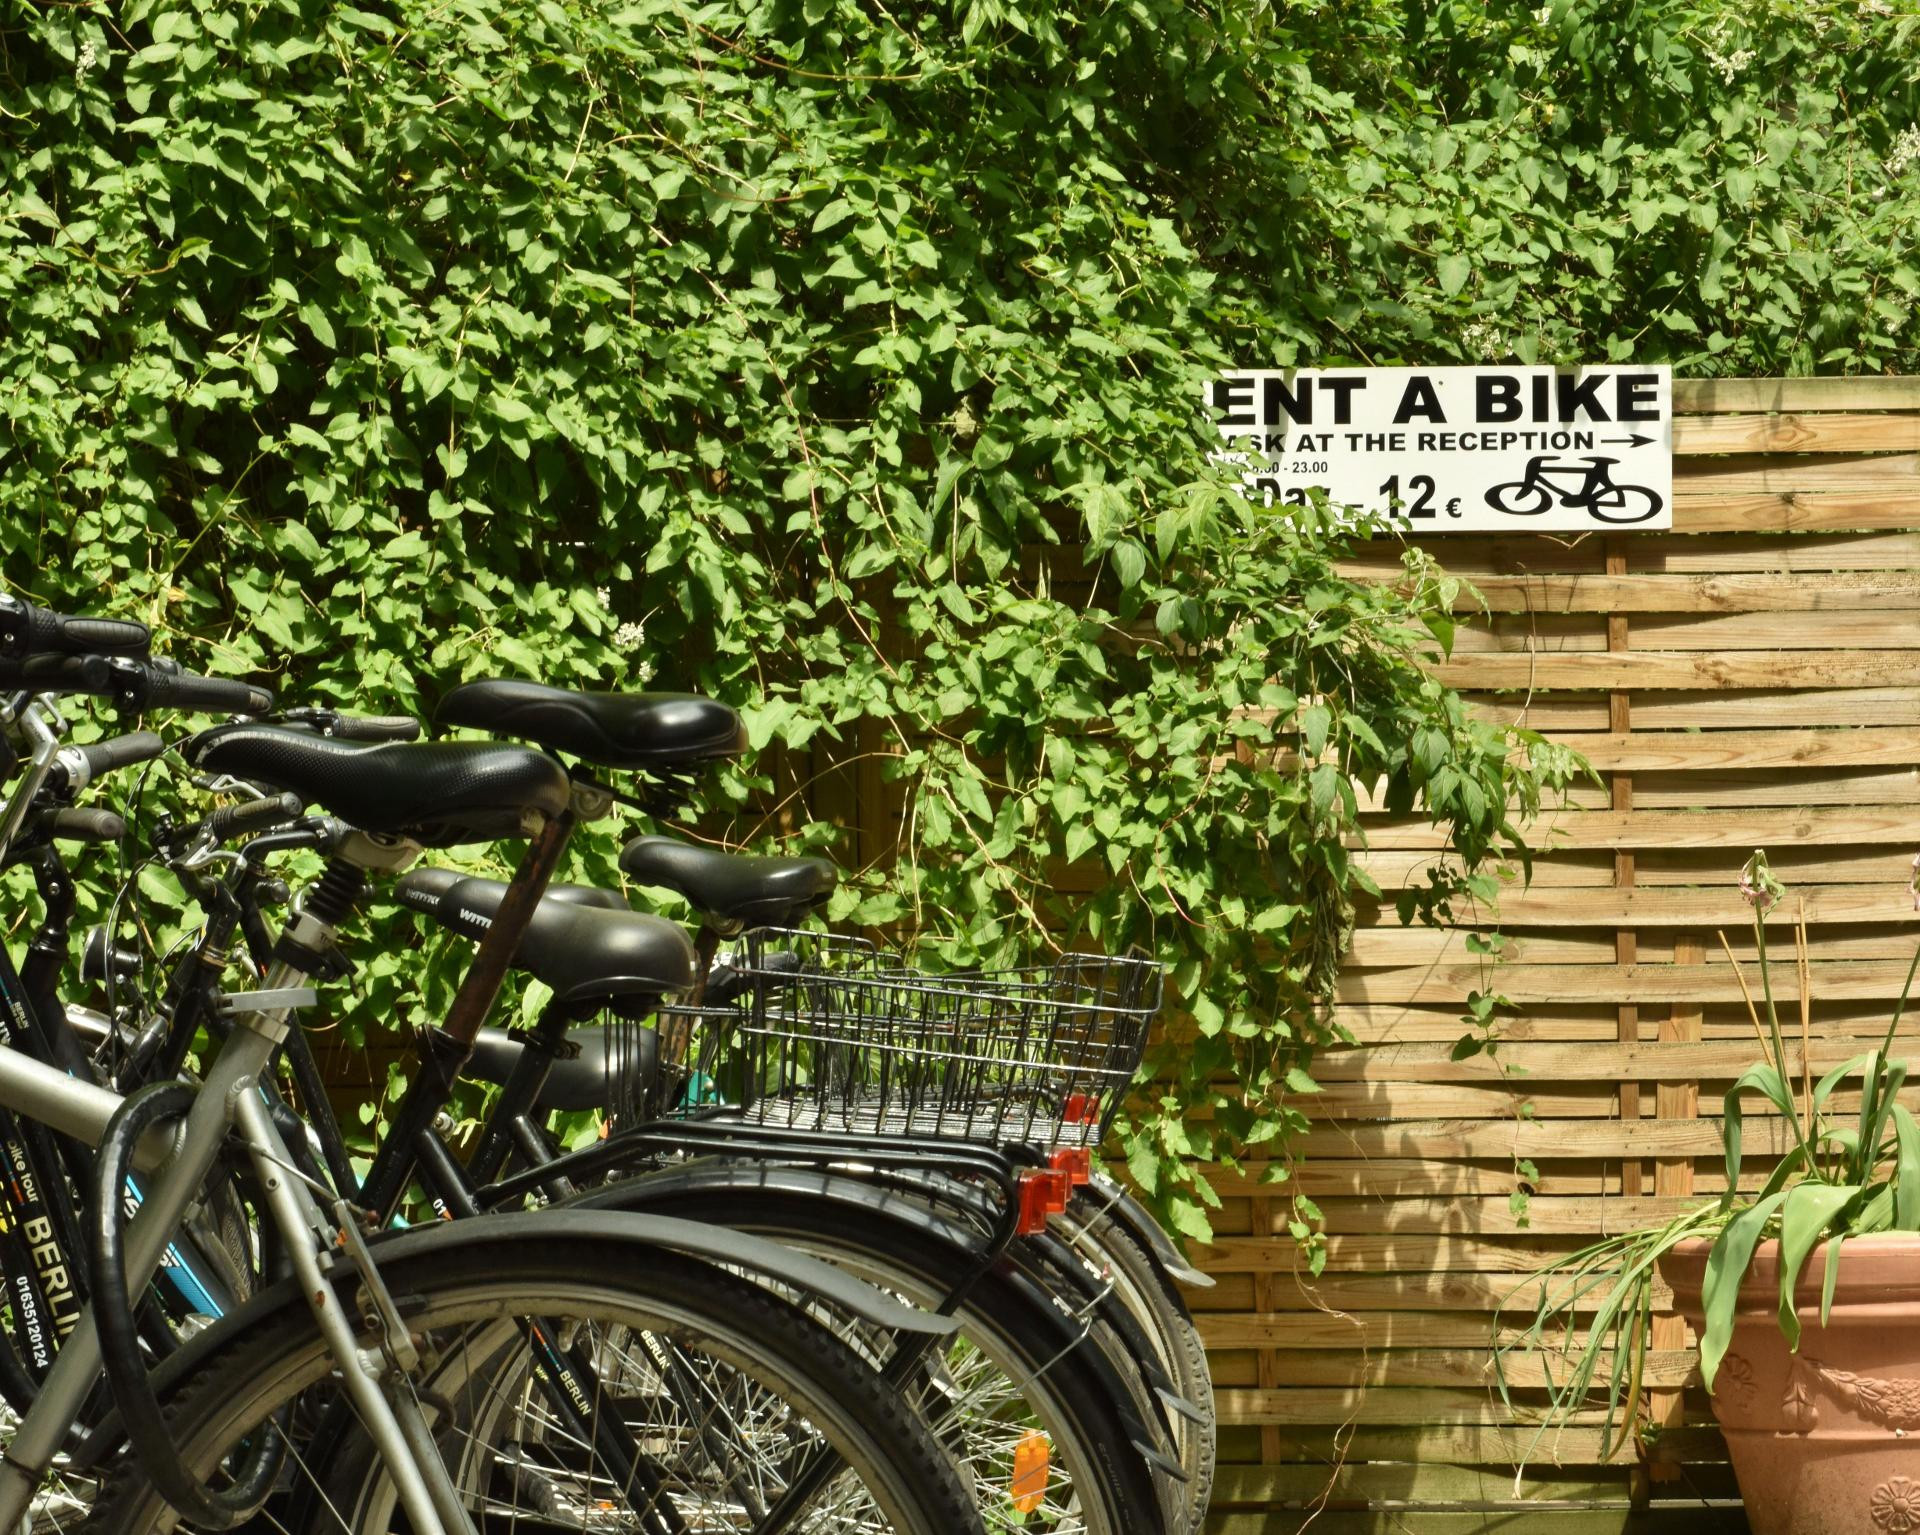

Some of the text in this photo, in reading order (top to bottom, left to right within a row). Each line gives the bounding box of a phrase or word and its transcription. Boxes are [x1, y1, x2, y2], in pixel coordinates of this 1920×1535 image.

[1213, 373, 1661, 426] ENT A BIKE
[1296, 433, 1335, 452] AT
[1344, 432, 1407, 452] THE
[1418, 431, 1594, 451] RECEPTION
[1292, 461, 1328, 473] 23.00
[1256, 477, 1332, 508] Da
[1379, 474, 1437, 519] 12
[1445, 497, 1463, 519] €
[460, 908, 493, 929] WITT
[20, 1172, 40, 1203] tour
[16, 1275, 49, 1369] 01635120124
[640, 1329, 671, 1370] BERLIN
[559, 1369, 592, 1416] BERLIN
